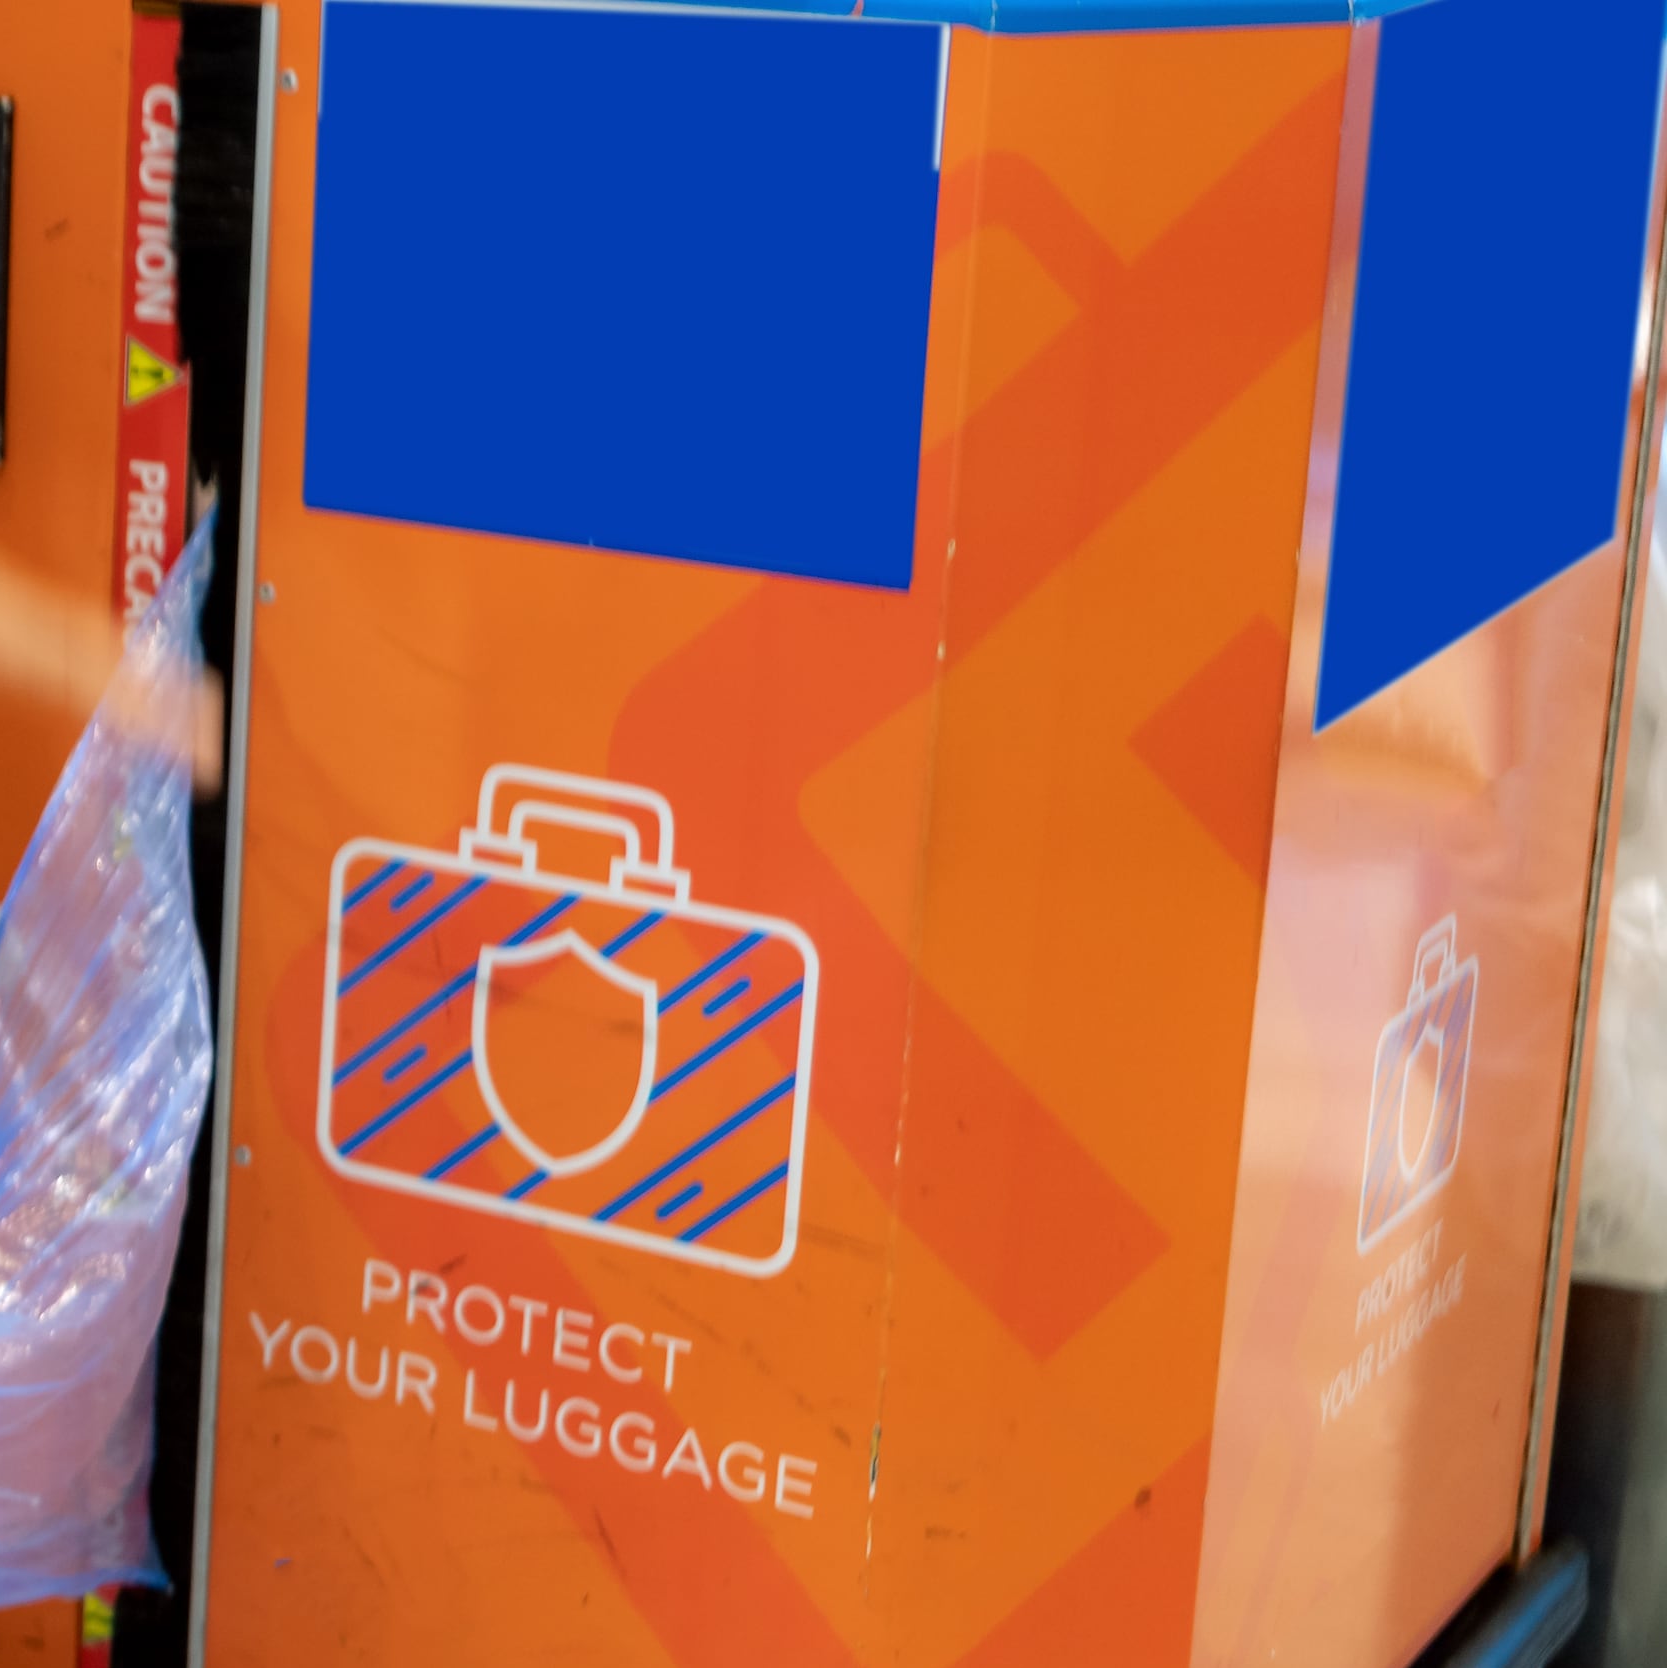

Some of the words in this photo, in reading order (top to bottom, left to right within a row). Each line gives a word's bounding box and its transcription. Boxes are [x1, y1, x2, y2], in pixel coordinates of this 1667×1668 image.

[134, 84, 180, 324] CAUTION
[361, 1257, 693, 1393] PROTECT
[1355, 1217, 1444, 1338] PROTECT
[248, 1311, 438, 1413] YOUR
[463, 1369, 818, 1519] LUGGAGE
[1321, 1343, 1374, 1426] YOUR
